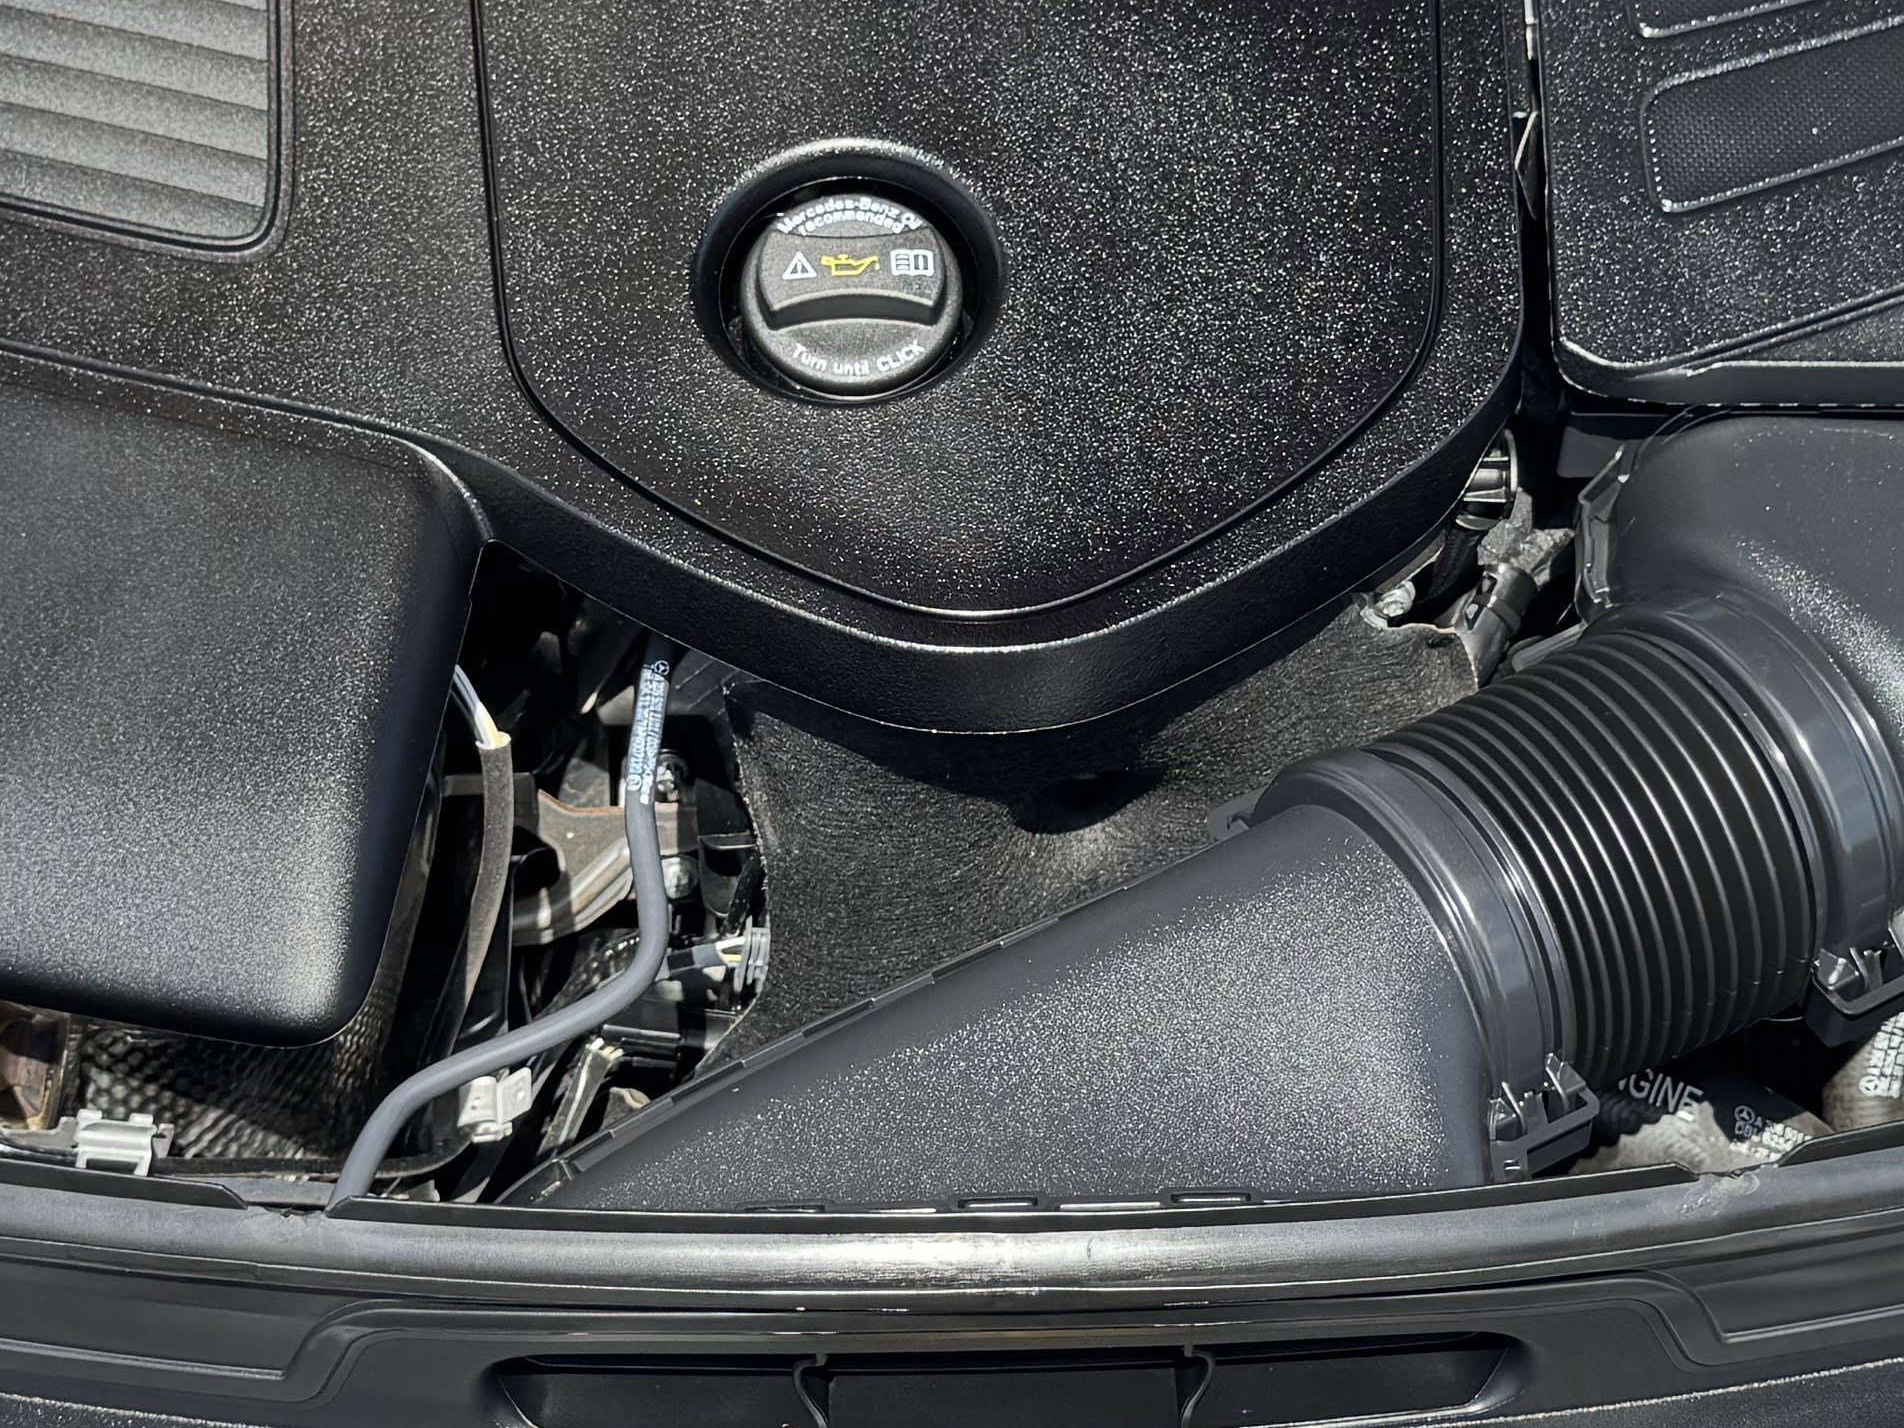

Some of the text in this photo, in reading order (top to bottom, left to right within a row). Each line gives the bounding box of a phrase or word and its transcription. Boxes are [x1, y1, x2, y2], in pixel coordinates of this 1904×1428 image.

[776, 197, 900, 233] Mercedes-Benz
[798, 210, 905, 236] recommended
[793, 338, 925, 376] Turn until CLICK
[1619, 1068, 1703, 1122] GINE
